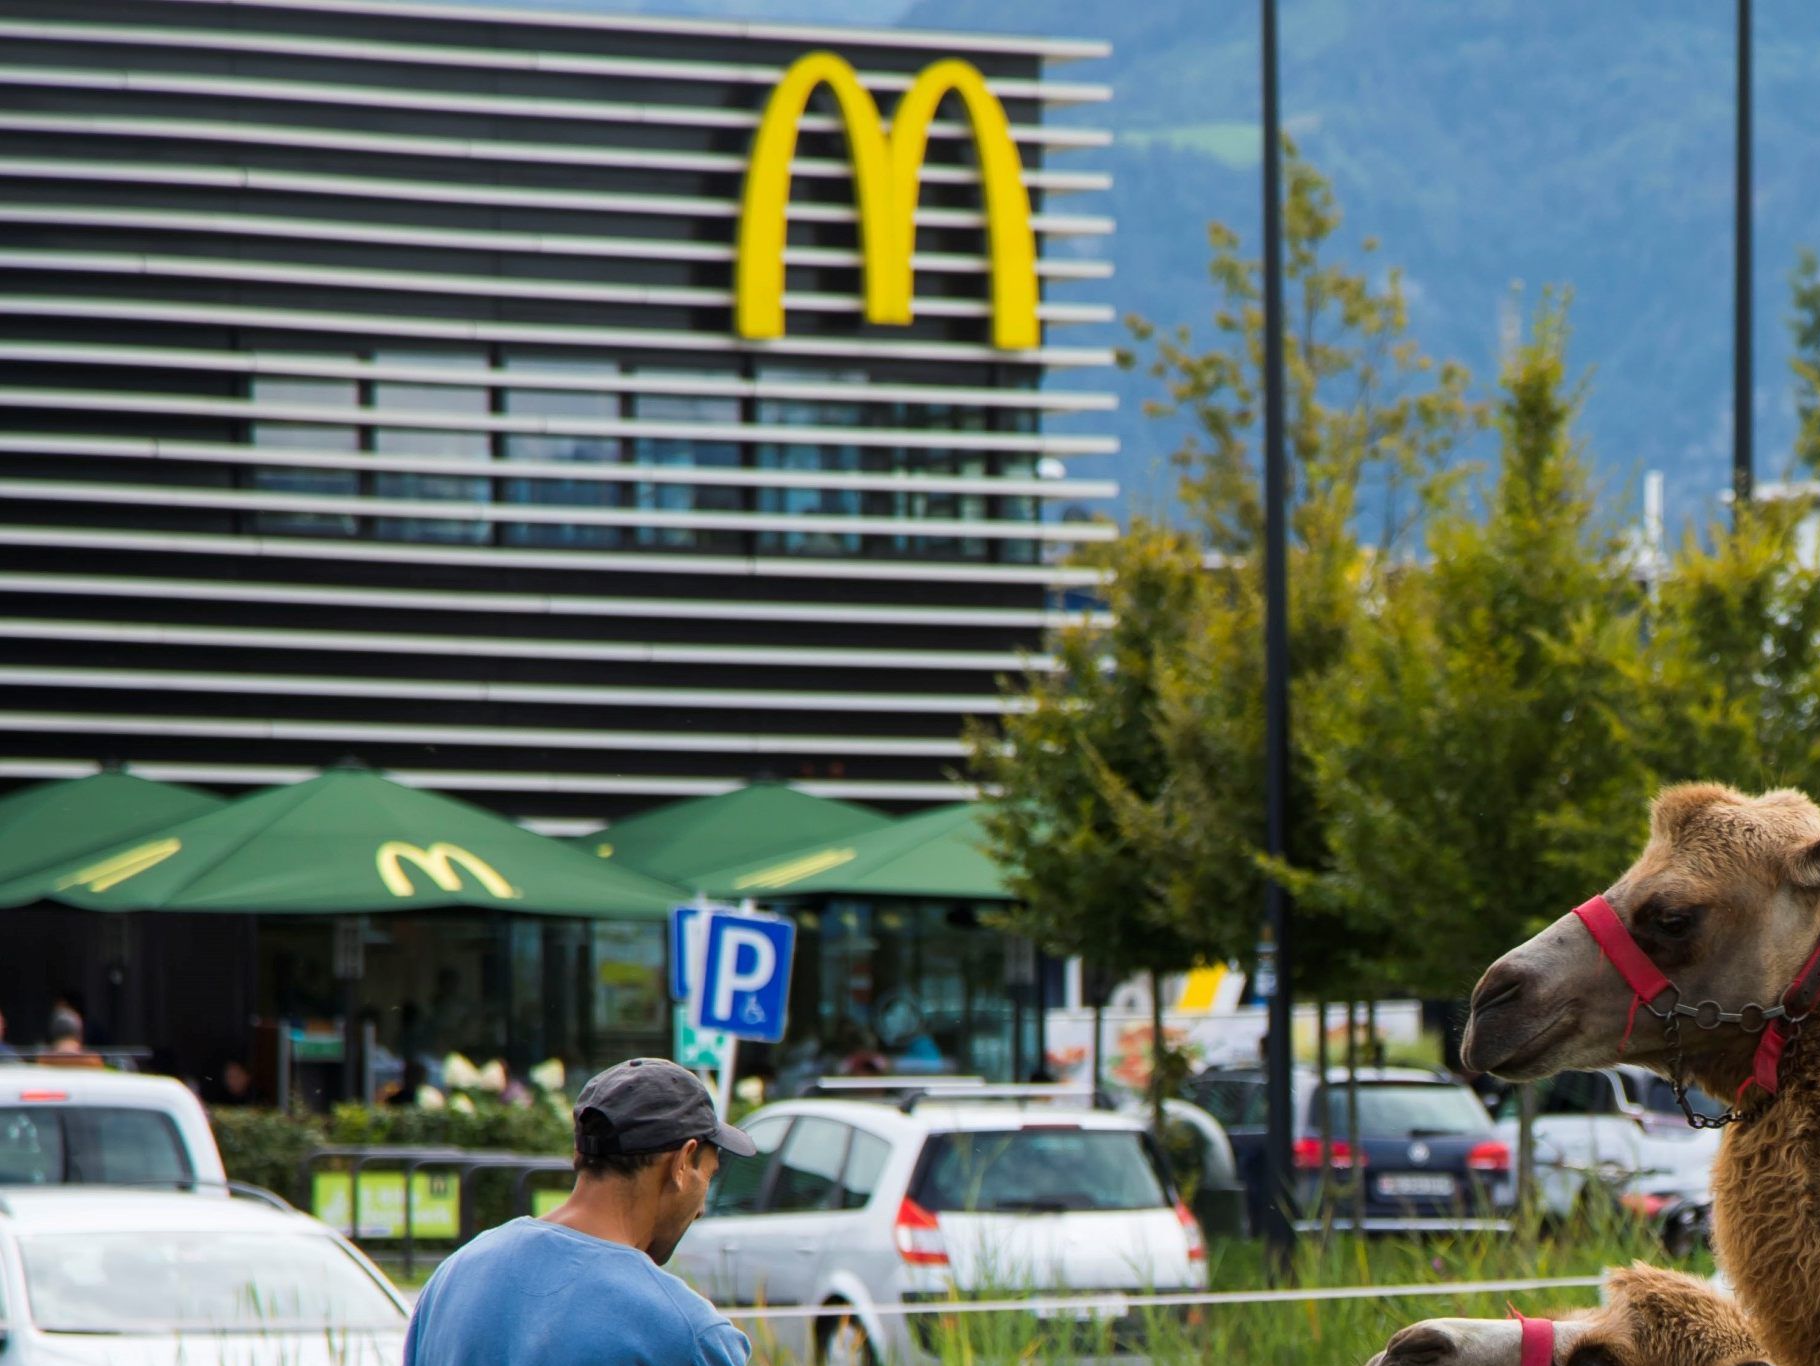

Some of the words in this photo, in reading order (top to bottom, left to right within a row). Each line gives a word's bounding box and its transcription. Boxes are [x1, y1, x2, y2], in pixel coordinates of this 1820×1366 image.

[736, 50, 1041, 350] M
[376, 840, 514, 899] M
[713, 926, 777, 1022] P
